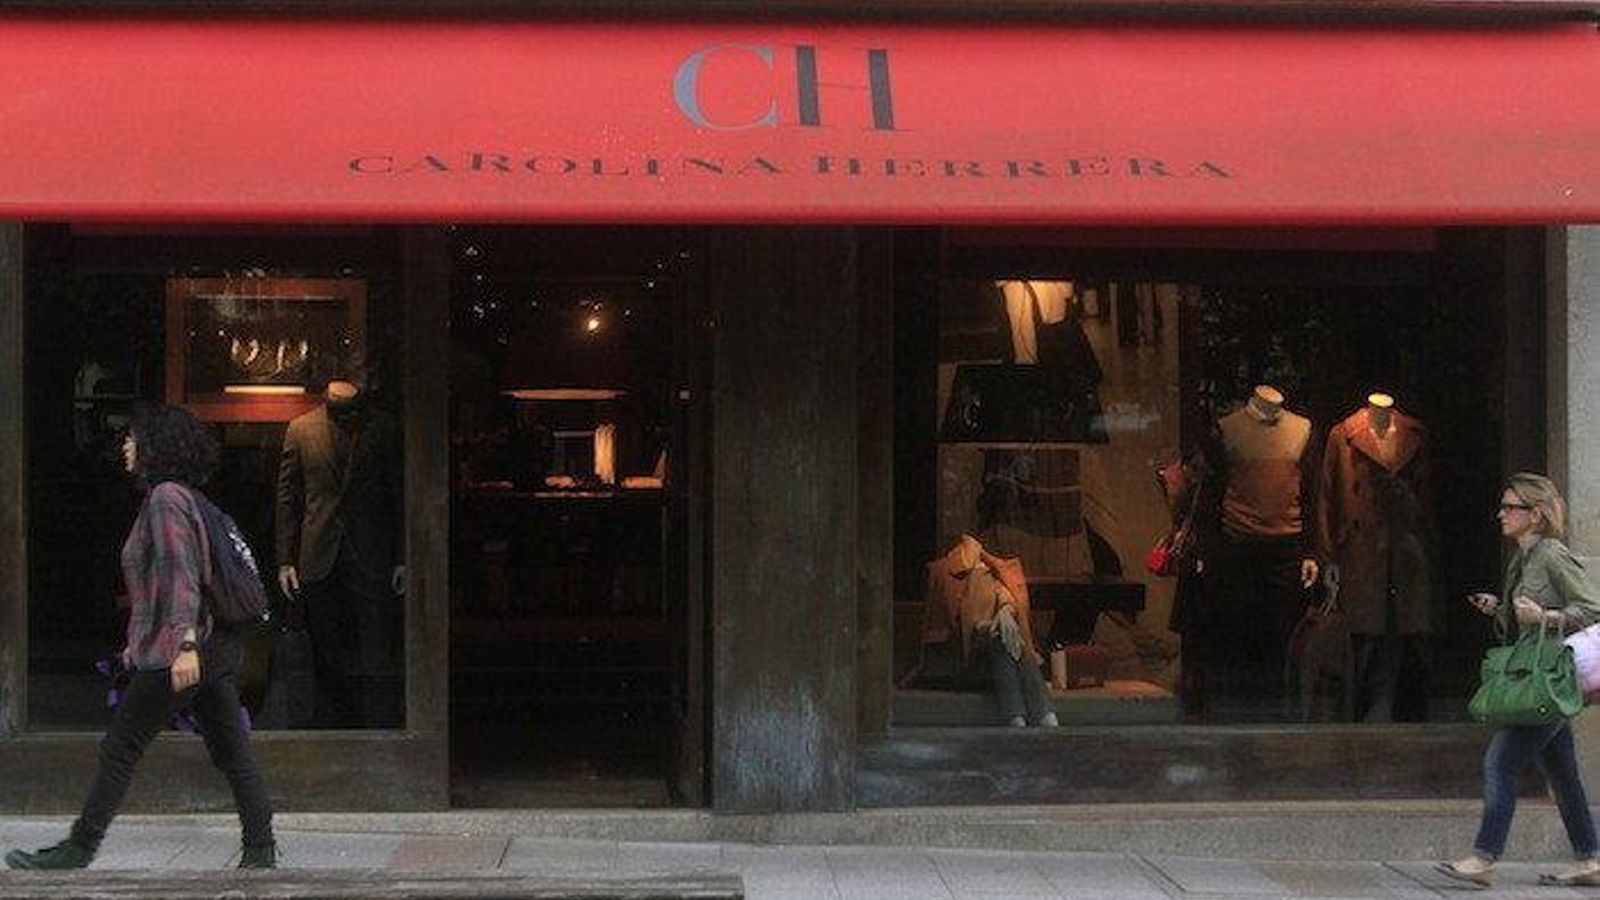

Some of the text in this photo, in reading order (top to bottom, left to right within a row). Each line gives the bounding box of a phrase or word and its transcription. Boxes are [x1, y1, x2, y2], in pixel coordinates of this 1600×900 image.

[672, 43, 905, 132] CH
[348, 152, 1236, 178] CAROLINA HERRERA
